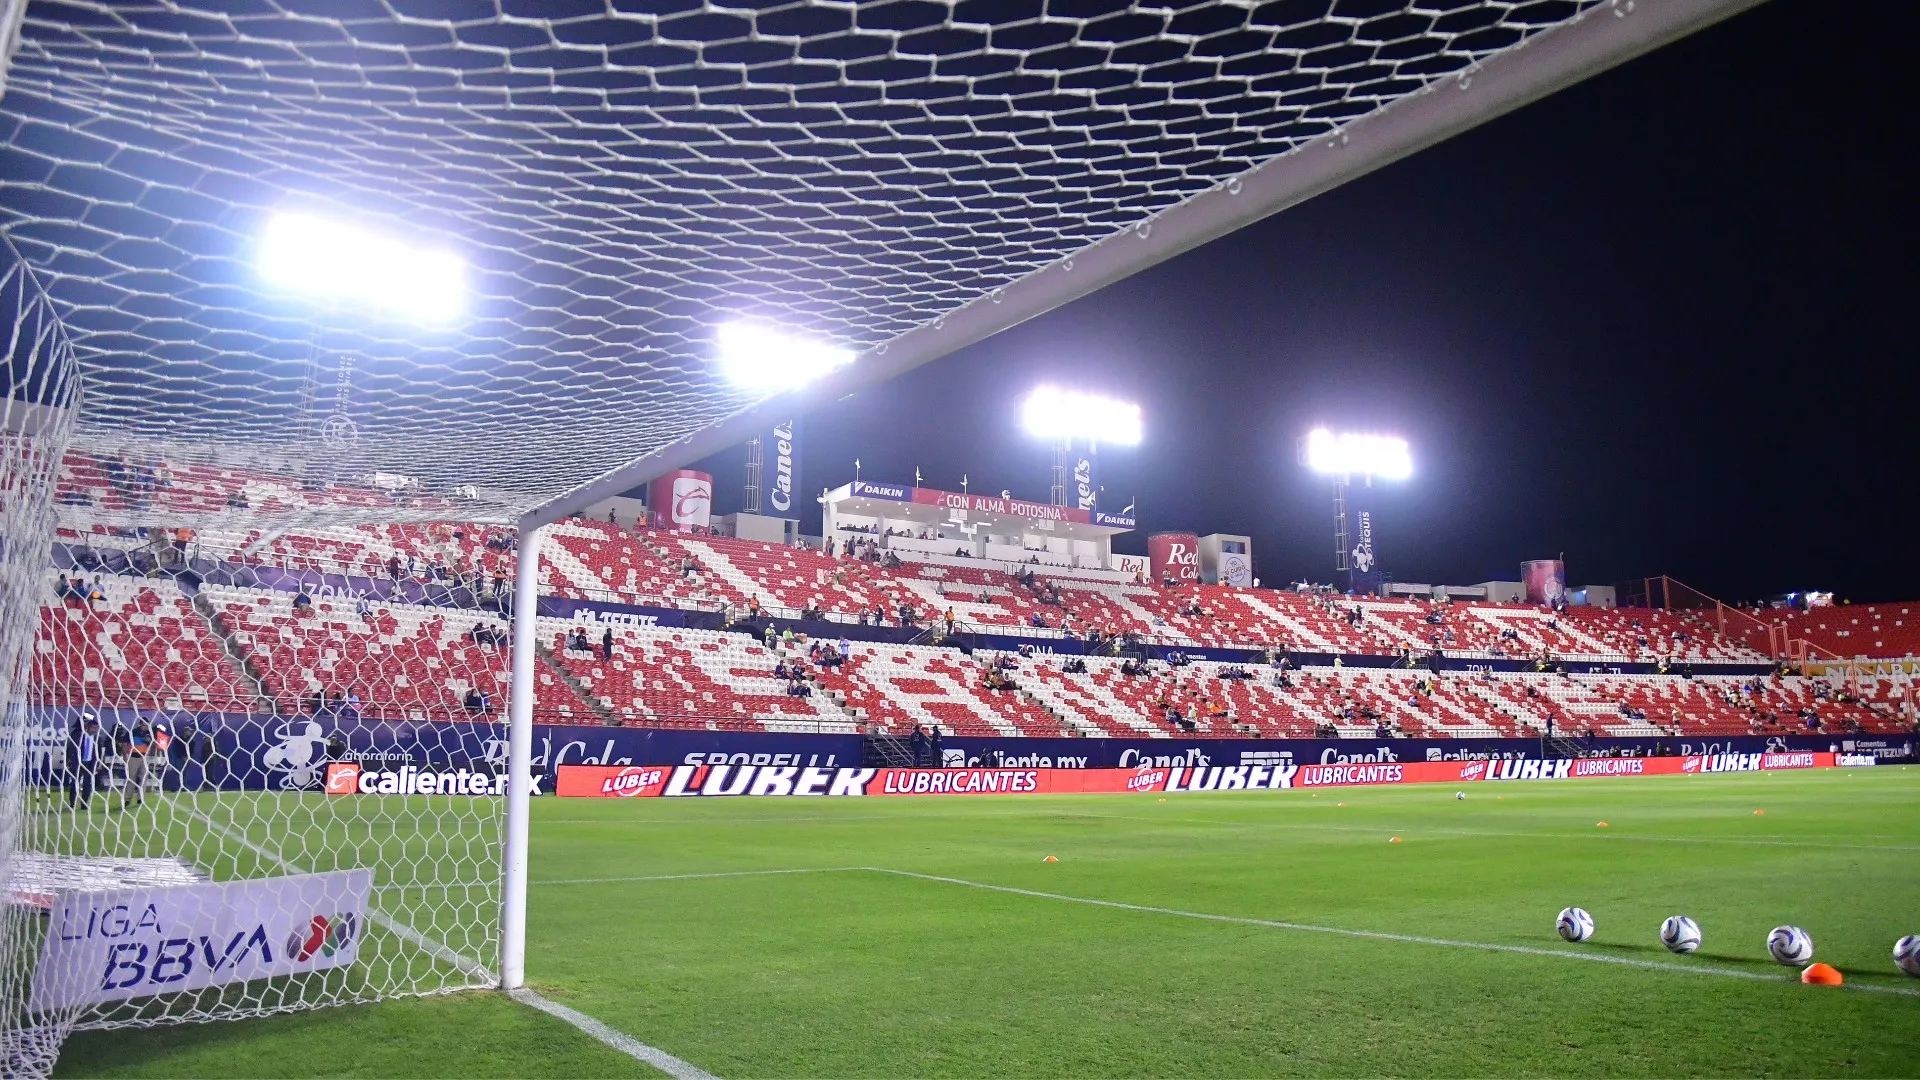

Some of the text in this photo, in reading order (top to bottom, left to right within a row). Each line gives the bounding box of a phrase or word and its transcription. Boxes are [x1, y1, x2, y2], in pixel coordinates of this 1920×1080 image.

[771, 419, 793, 511] Canel
[864, 485, 904, 498] DAIKIN
[1074, 457, 1091, 511] nel's
[946, 494, 1062, 521] CON ALMA POTOSINA
[1104, 515, 1136, 526] DAIKIN
[1362, 511, 1372, 549] TEQUIS
[1120, 557, 1144, 573] Red
[1165, 543, 1199, 566] Red
[599, 611, 659, 627] TECATE
[336, 747, 413, 761] aboratorio
[1700, 753, 1813, 772] LUBER LUBRICANTES
[664, 765, 1038, 797] LUBER LUBRICANTES
[1127, 770, 1164, 789] LUBER
[1165, 764, 1403, 791] LUBER LUBRICANTES
[1460, 763, 1484, 778] LUBER
[1484, 759, 1643, 780] LUBER LUBRICANTES
[602, 770, 662, 793] LUBER
[61, 902, 162, 941] LIGA
[100, 923, 273, 991] BBVA
